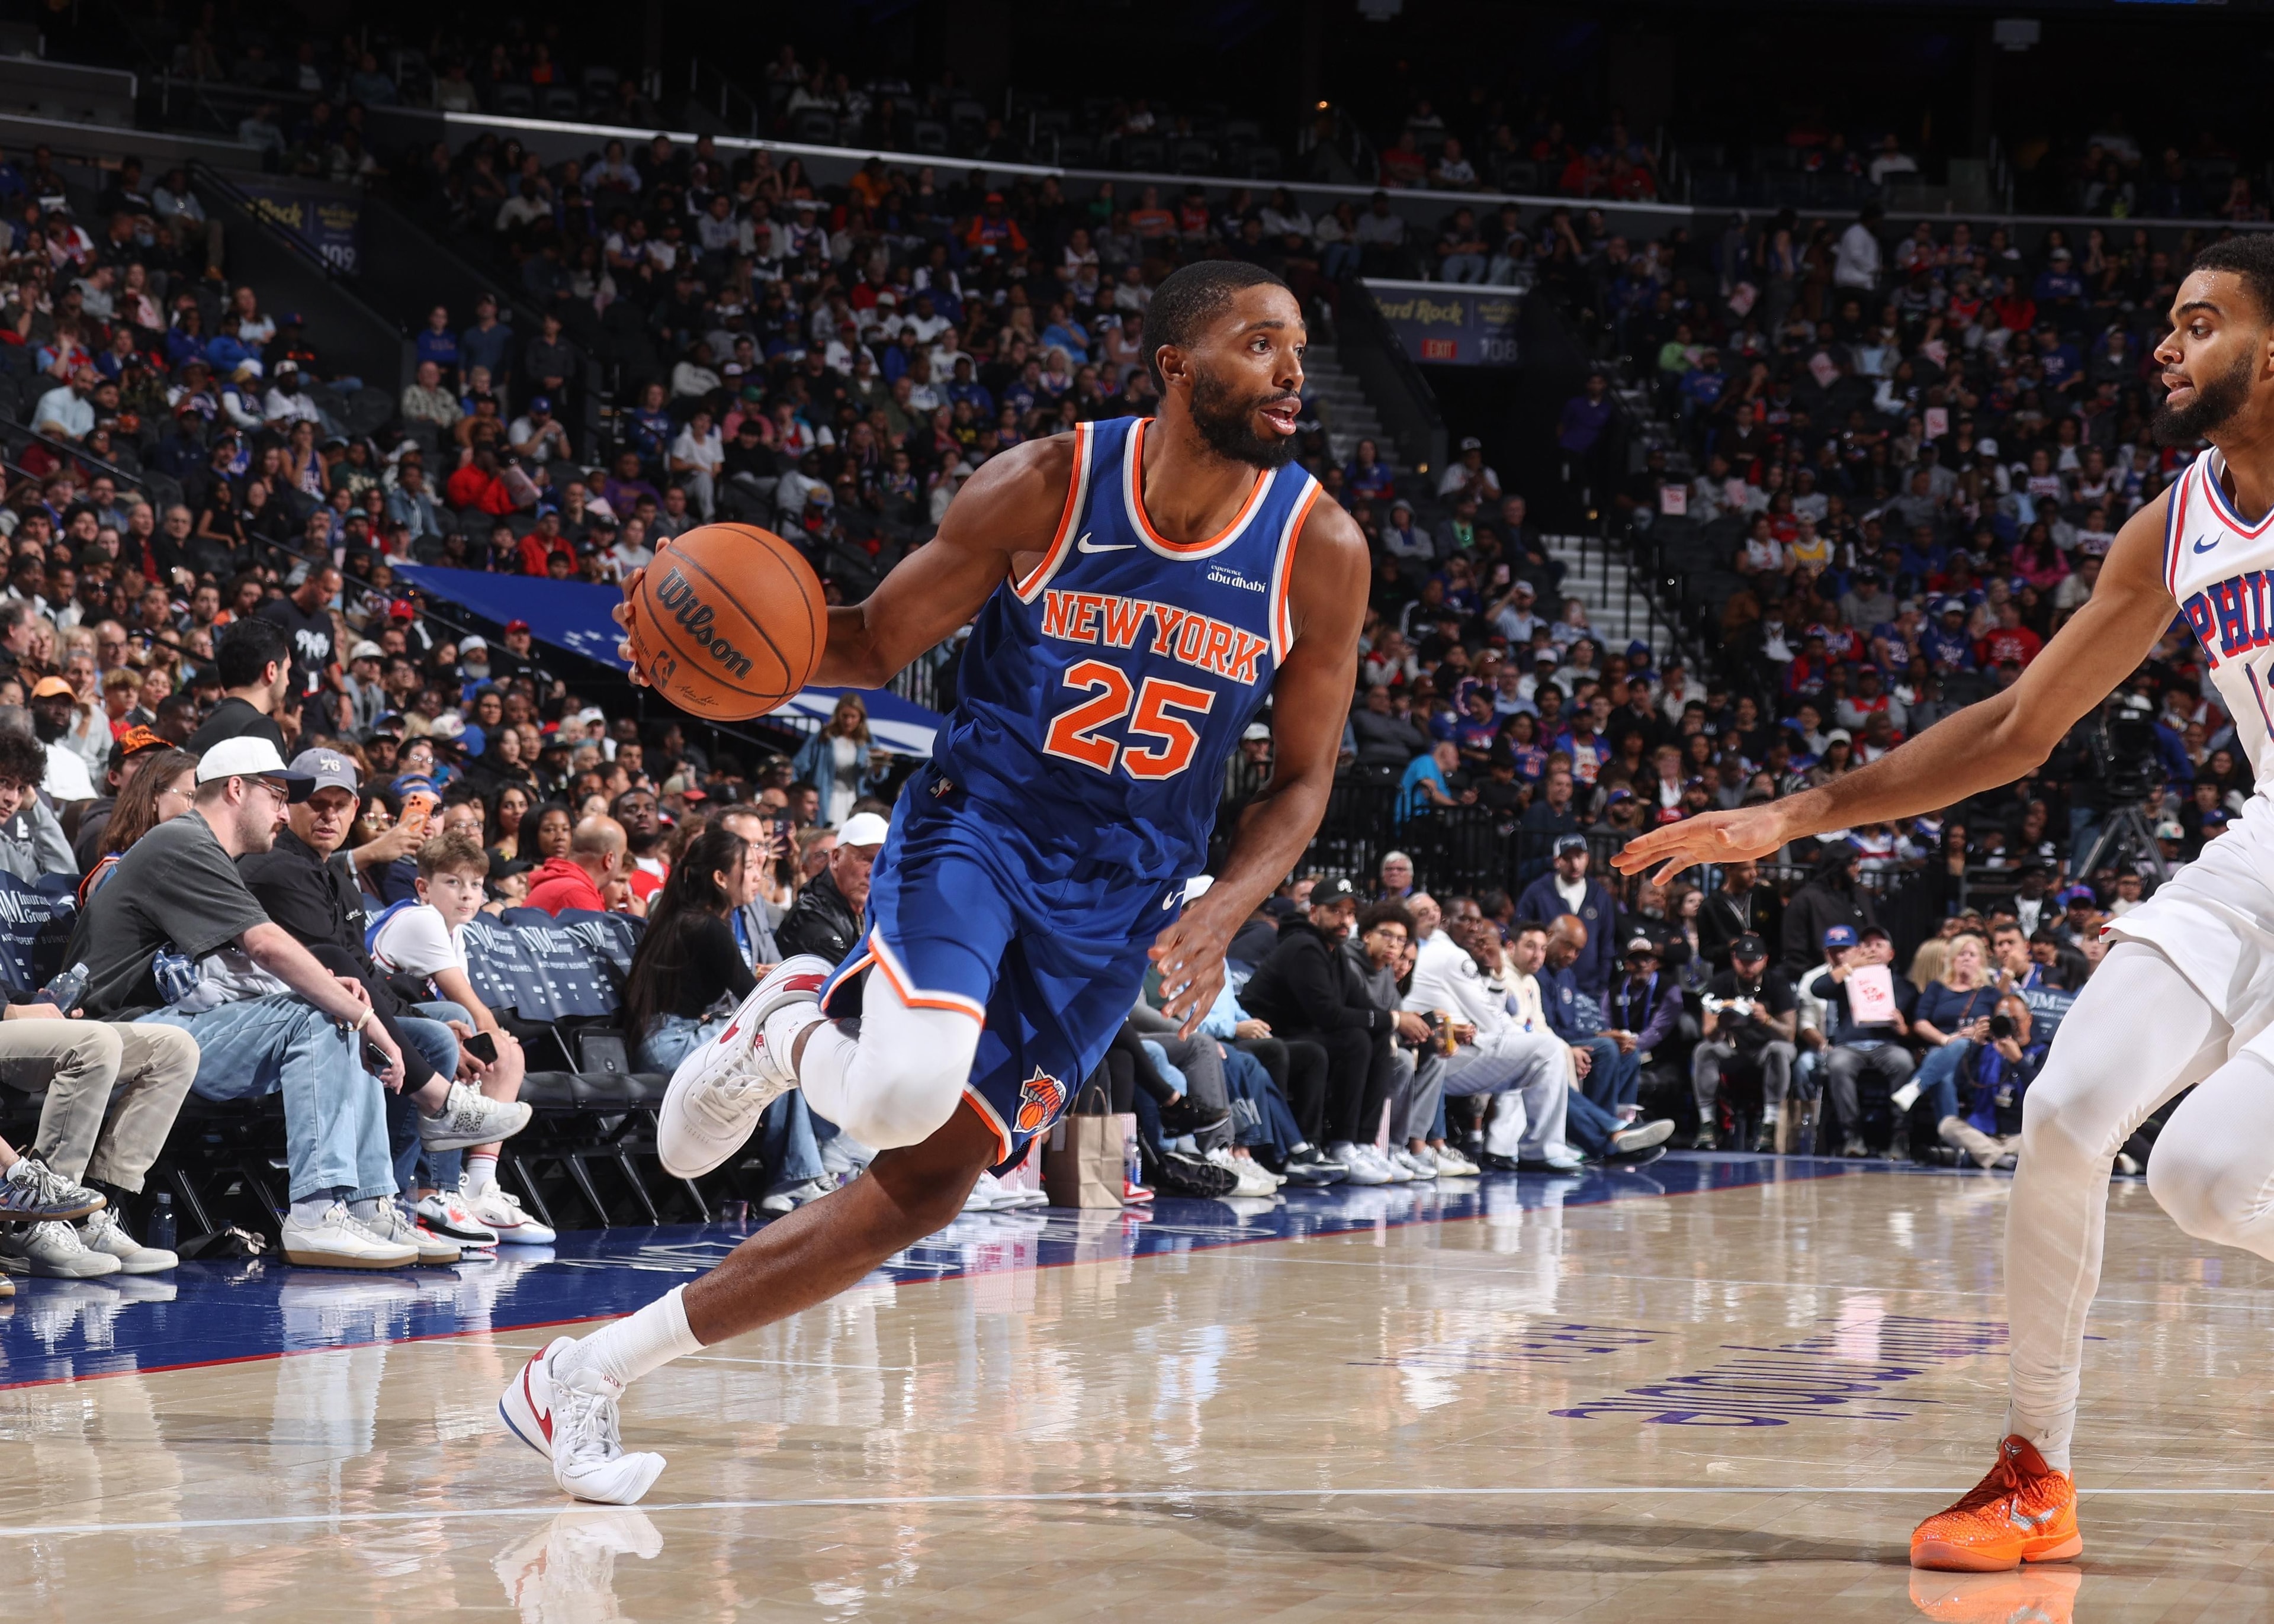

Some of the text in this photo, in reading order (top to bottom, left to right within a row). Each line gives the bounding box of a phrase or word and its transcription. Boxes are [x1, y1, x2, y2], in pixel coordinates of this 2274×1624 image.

[1415, 298, 1463, 326] Rock
[1428, 342, 1456, 358] EXIT
[1480, 338, 1518, 362] 108
[1211, 564, 1242, 576] experience
[1207, 571, 1267, 593] abu dhabi
[656, 567, 753, 680] Wilson
[1042, 589, 1271, 686] NEW YORK
[1042, 659, 1216, 781] 25
[320, 755, 341, 772] 76
[18, 891, 51, 906] Insuranc
[2016, 989, 2058, 1009] NJM
[754, 1034, 765, 1048] NIKE
[1548, 1359, 1944, 1427] mobile
